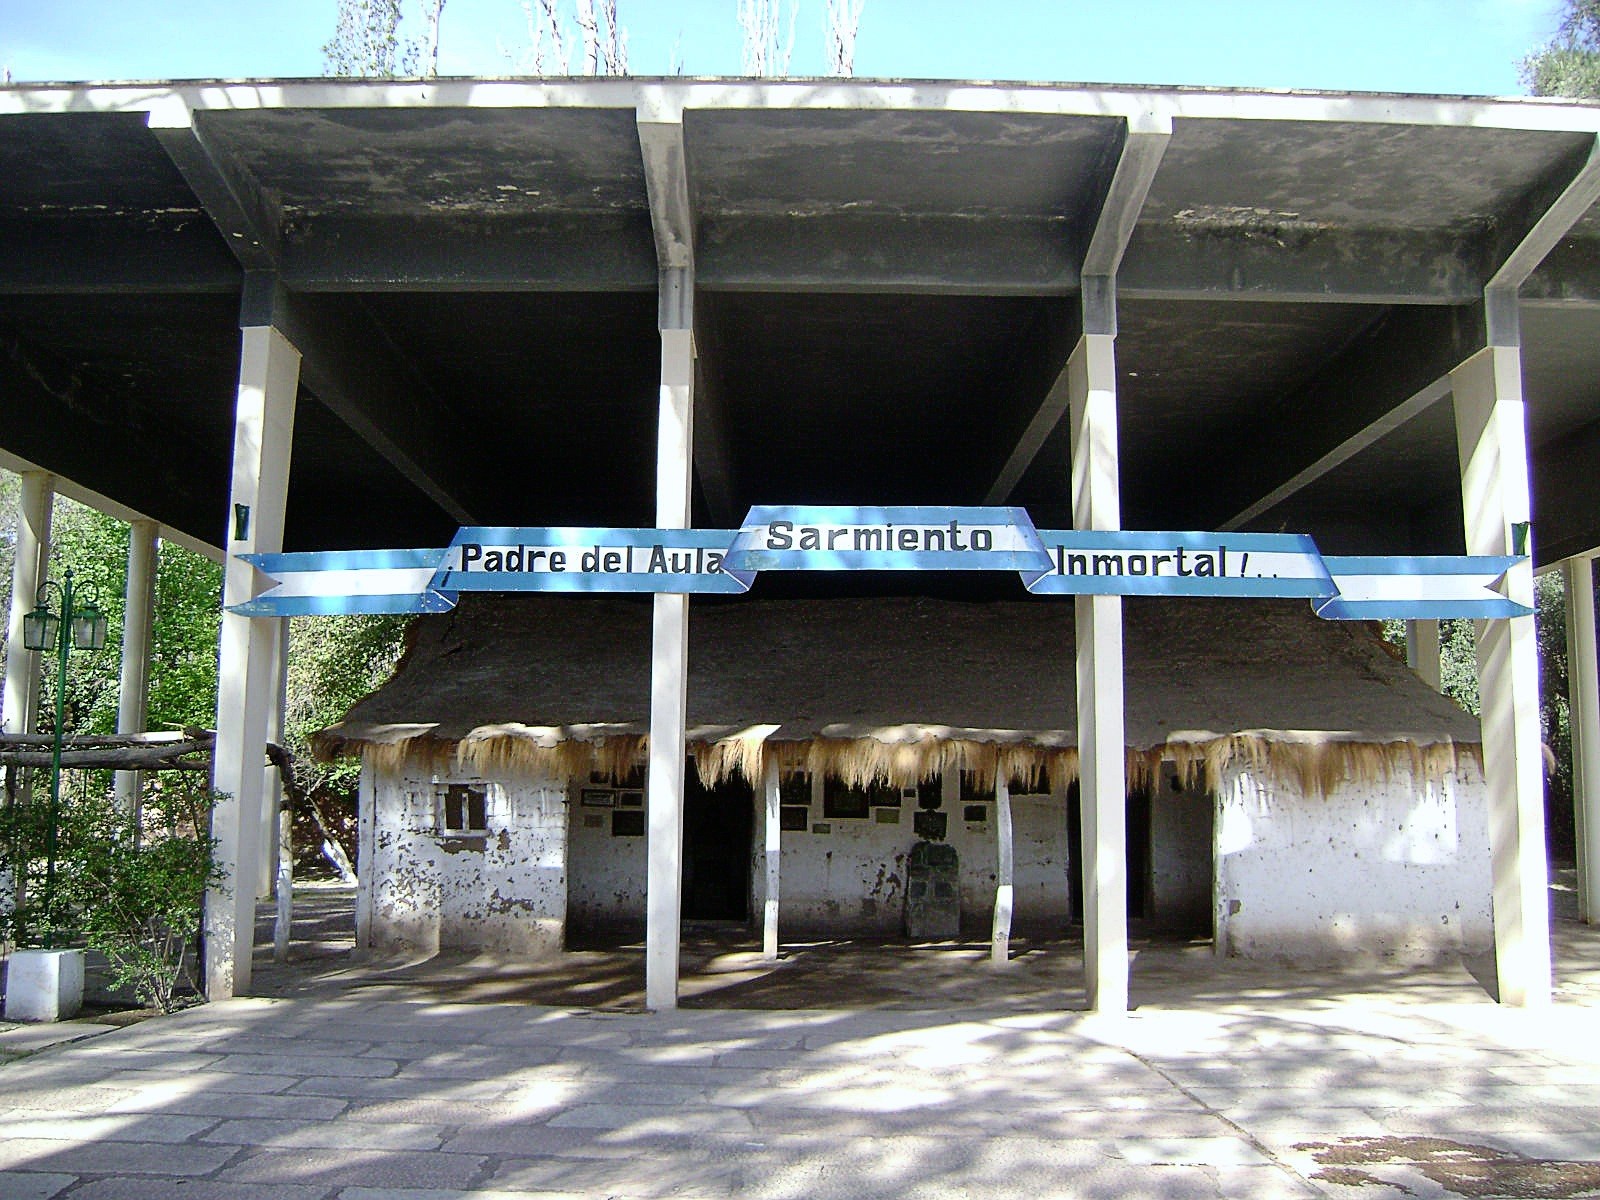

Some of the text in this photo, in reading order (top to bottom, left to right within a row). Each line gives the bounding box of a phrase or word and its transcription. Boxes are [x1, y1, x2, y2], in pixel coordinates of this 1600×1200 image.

[766, 520, 993, 551] Sarmiento
[580, 545, 632, 574] del
[647, 545, 725, 575] Aula
[1056, 545, 1226, 577] Inmortal
